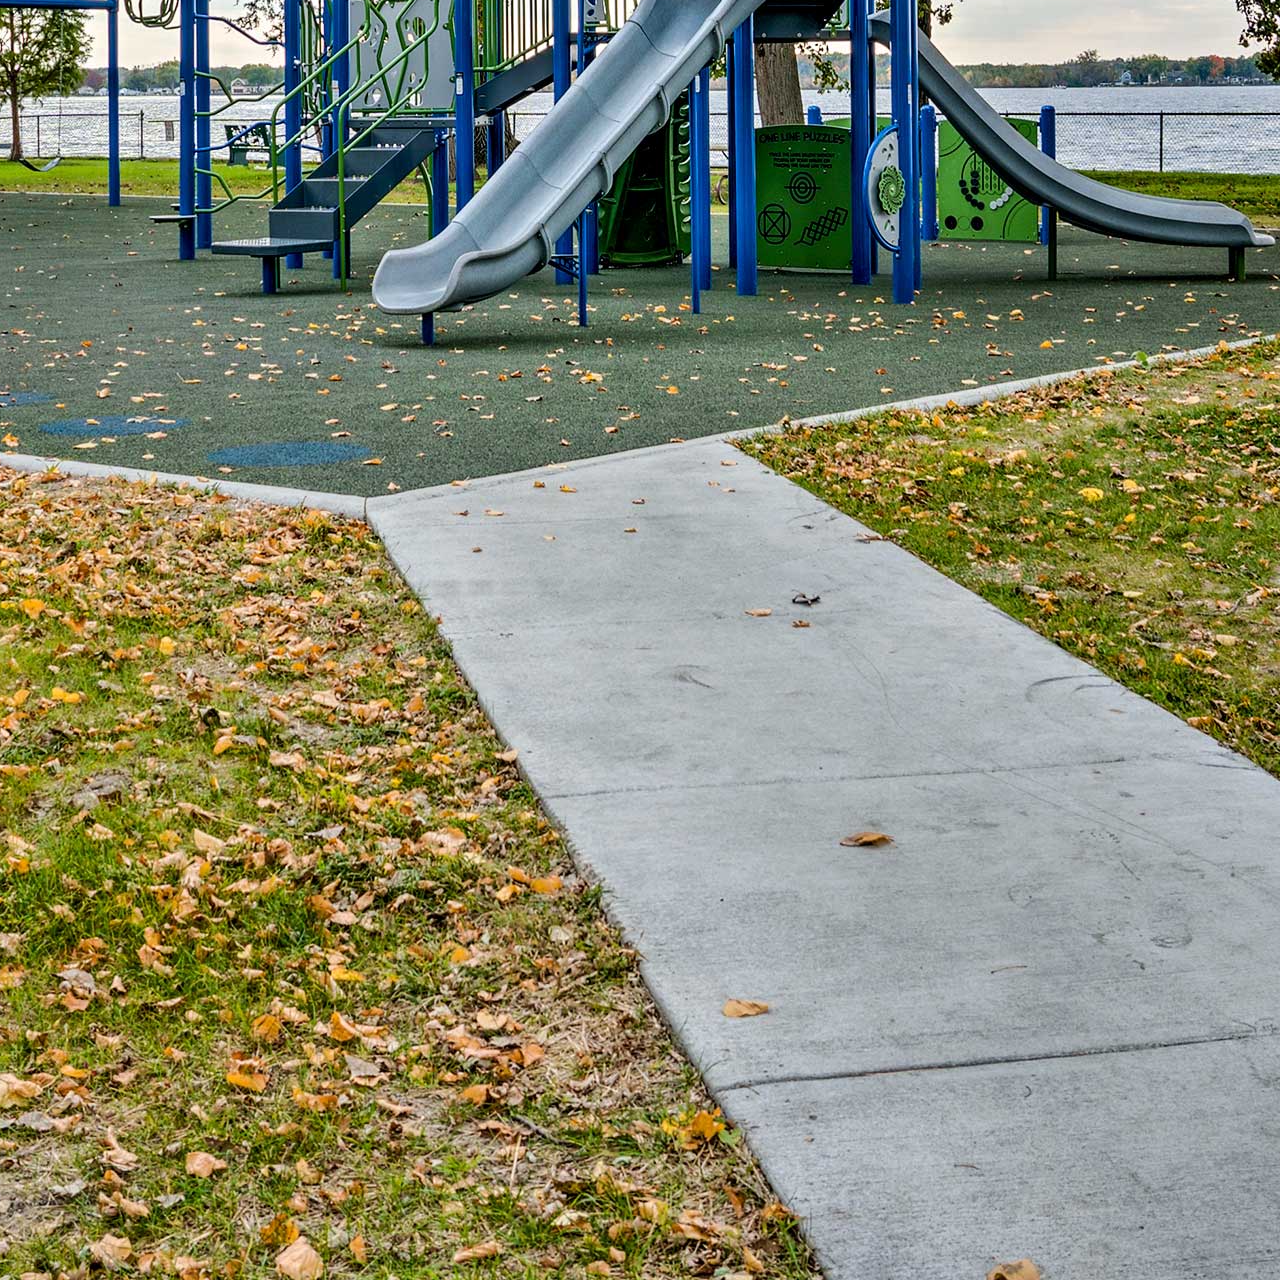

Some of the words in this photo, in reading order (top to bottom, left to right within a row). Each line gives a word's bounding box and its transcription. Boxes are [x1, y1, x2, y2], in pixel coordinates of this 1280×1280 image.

[759, 132, 779, 143] ONE
[780, 132, 801, 142] LINE
[802, 131, 846, 144] PUZZLES
